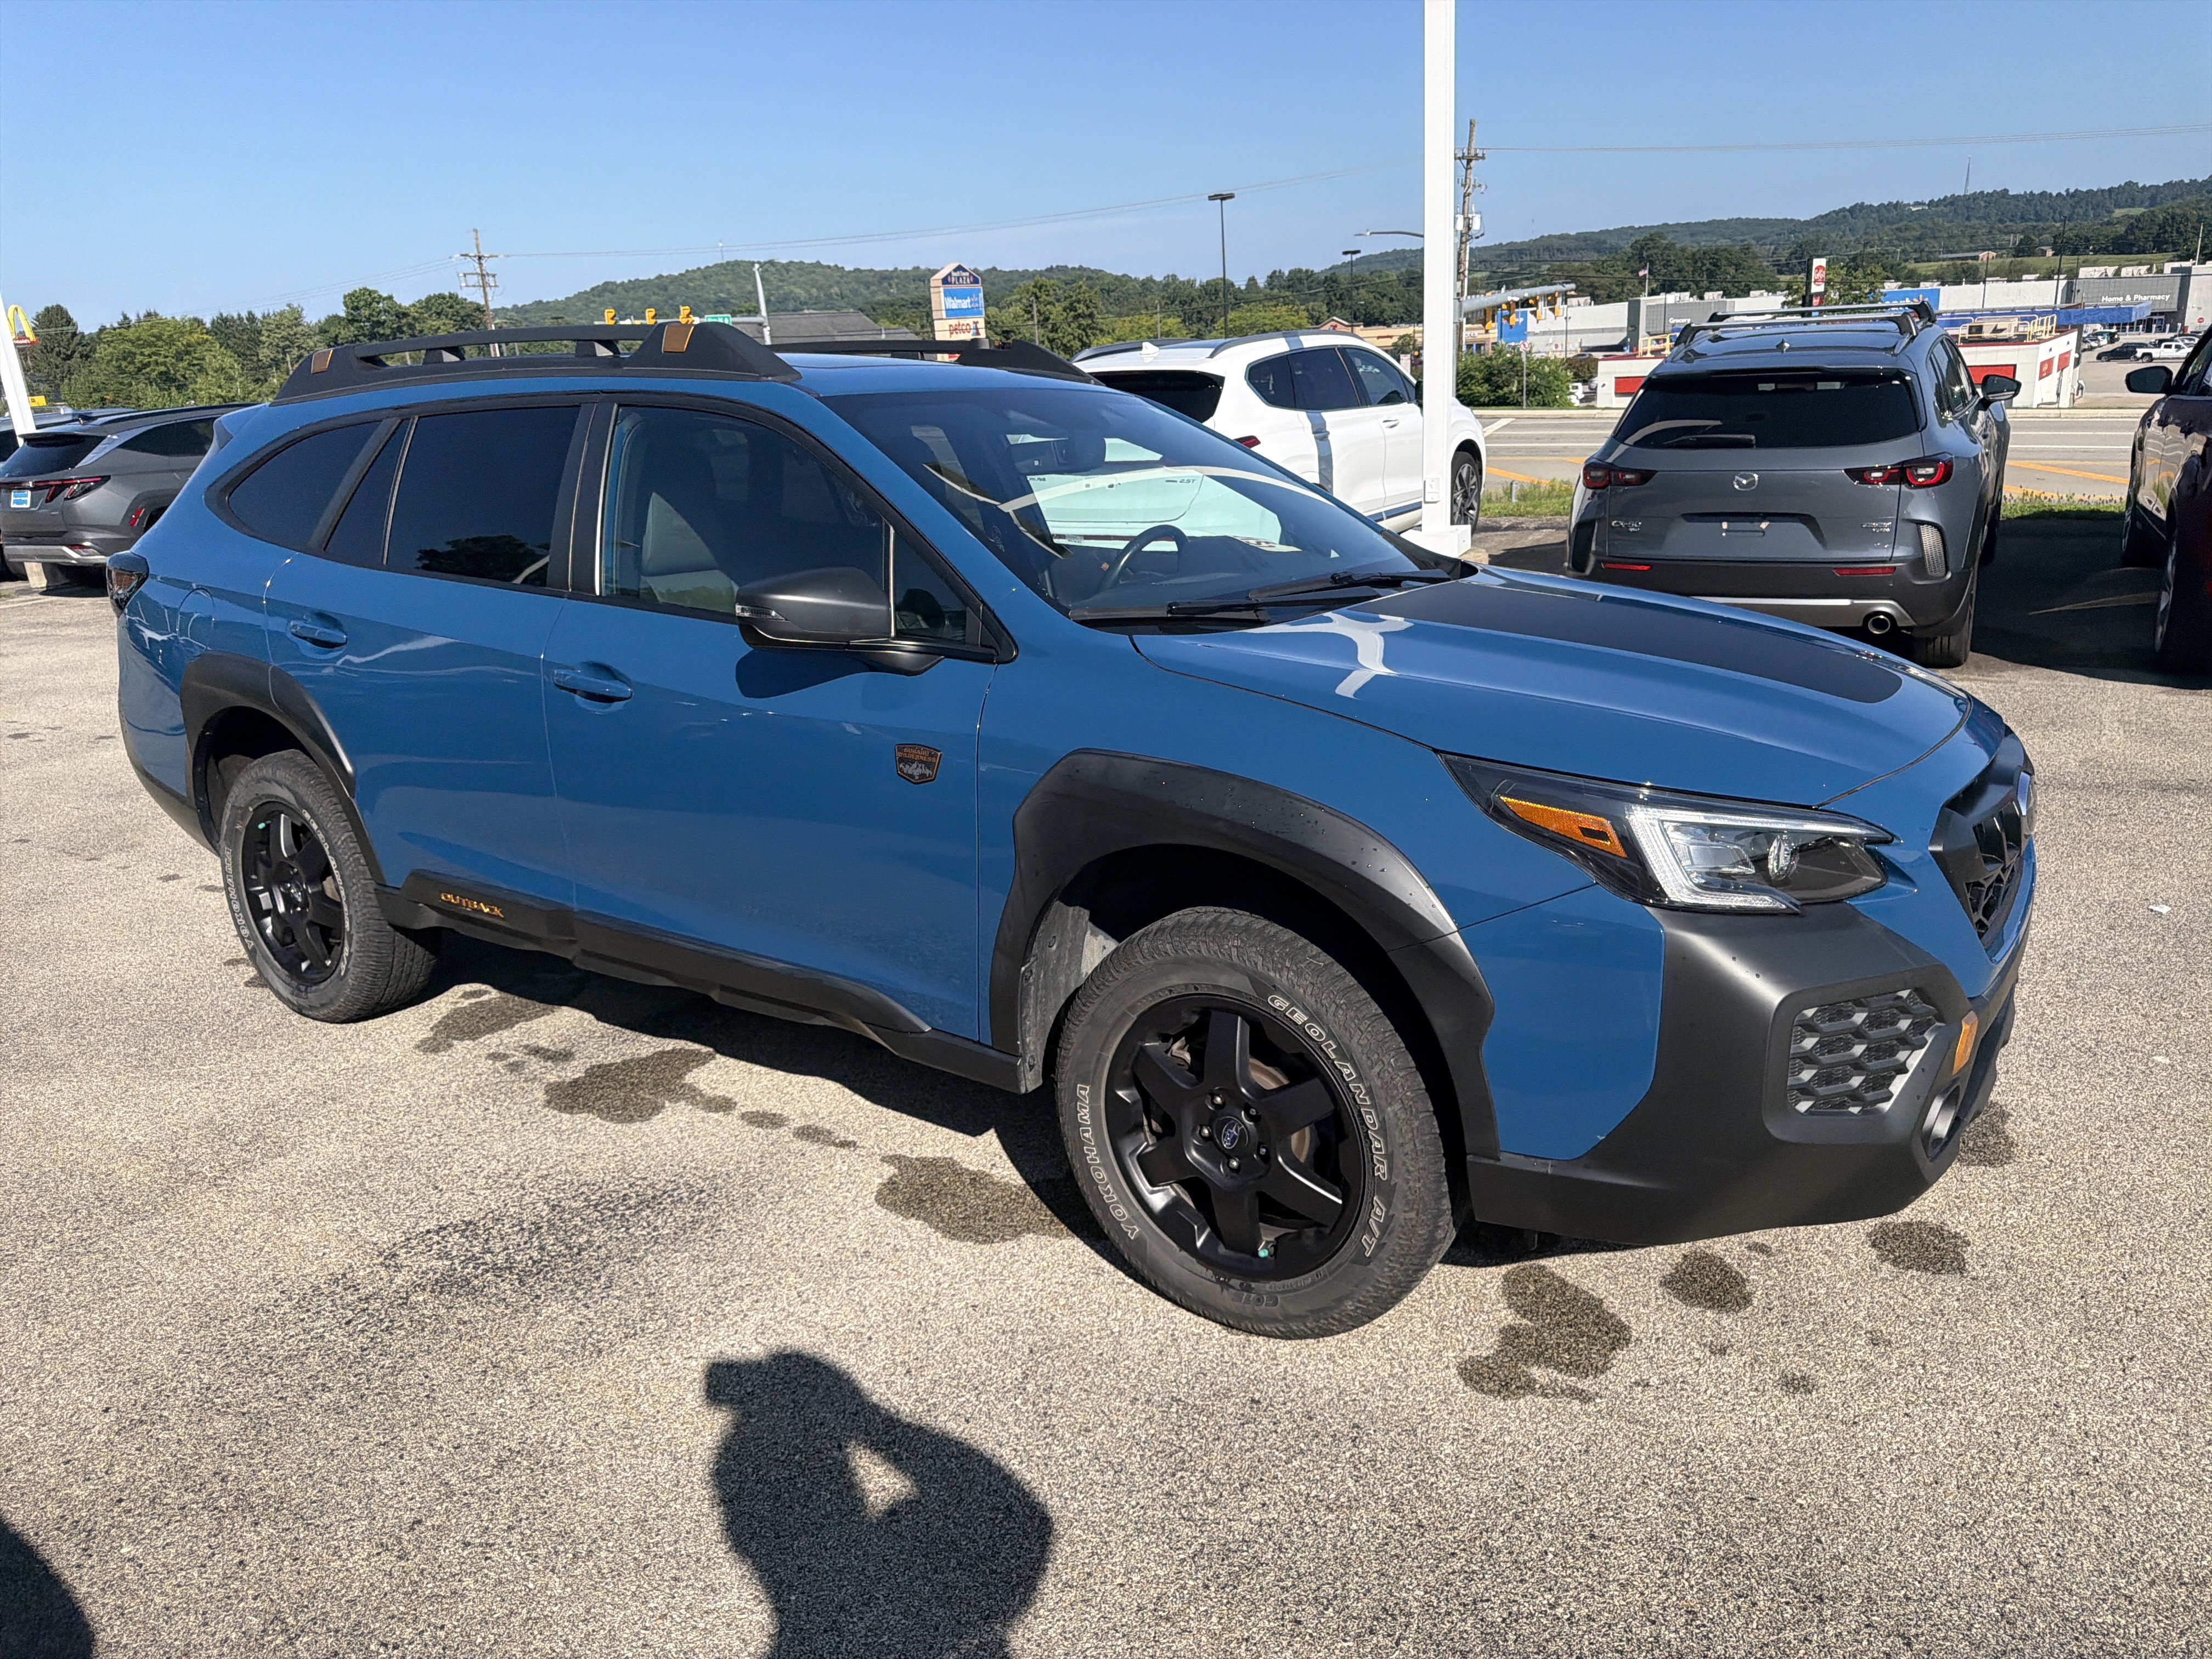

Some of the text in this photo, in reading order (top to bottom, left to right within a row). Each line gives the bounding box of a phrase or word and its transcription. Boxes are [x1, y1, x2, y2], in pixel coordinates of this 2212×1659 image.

[945, 296, 972, 309] Walmart
[949, 321, 971, 338] petco
[898, 752, 936, 763] WILDERNESS
[904, 748, 929, 757] SUBARU
[225, 847, 254, 950] YOKOHAMA
[1267, 995, 1387, 1257] GEOLANDAR A/T
[1077, 1084, 1141, 1239] YOKOHAMA
